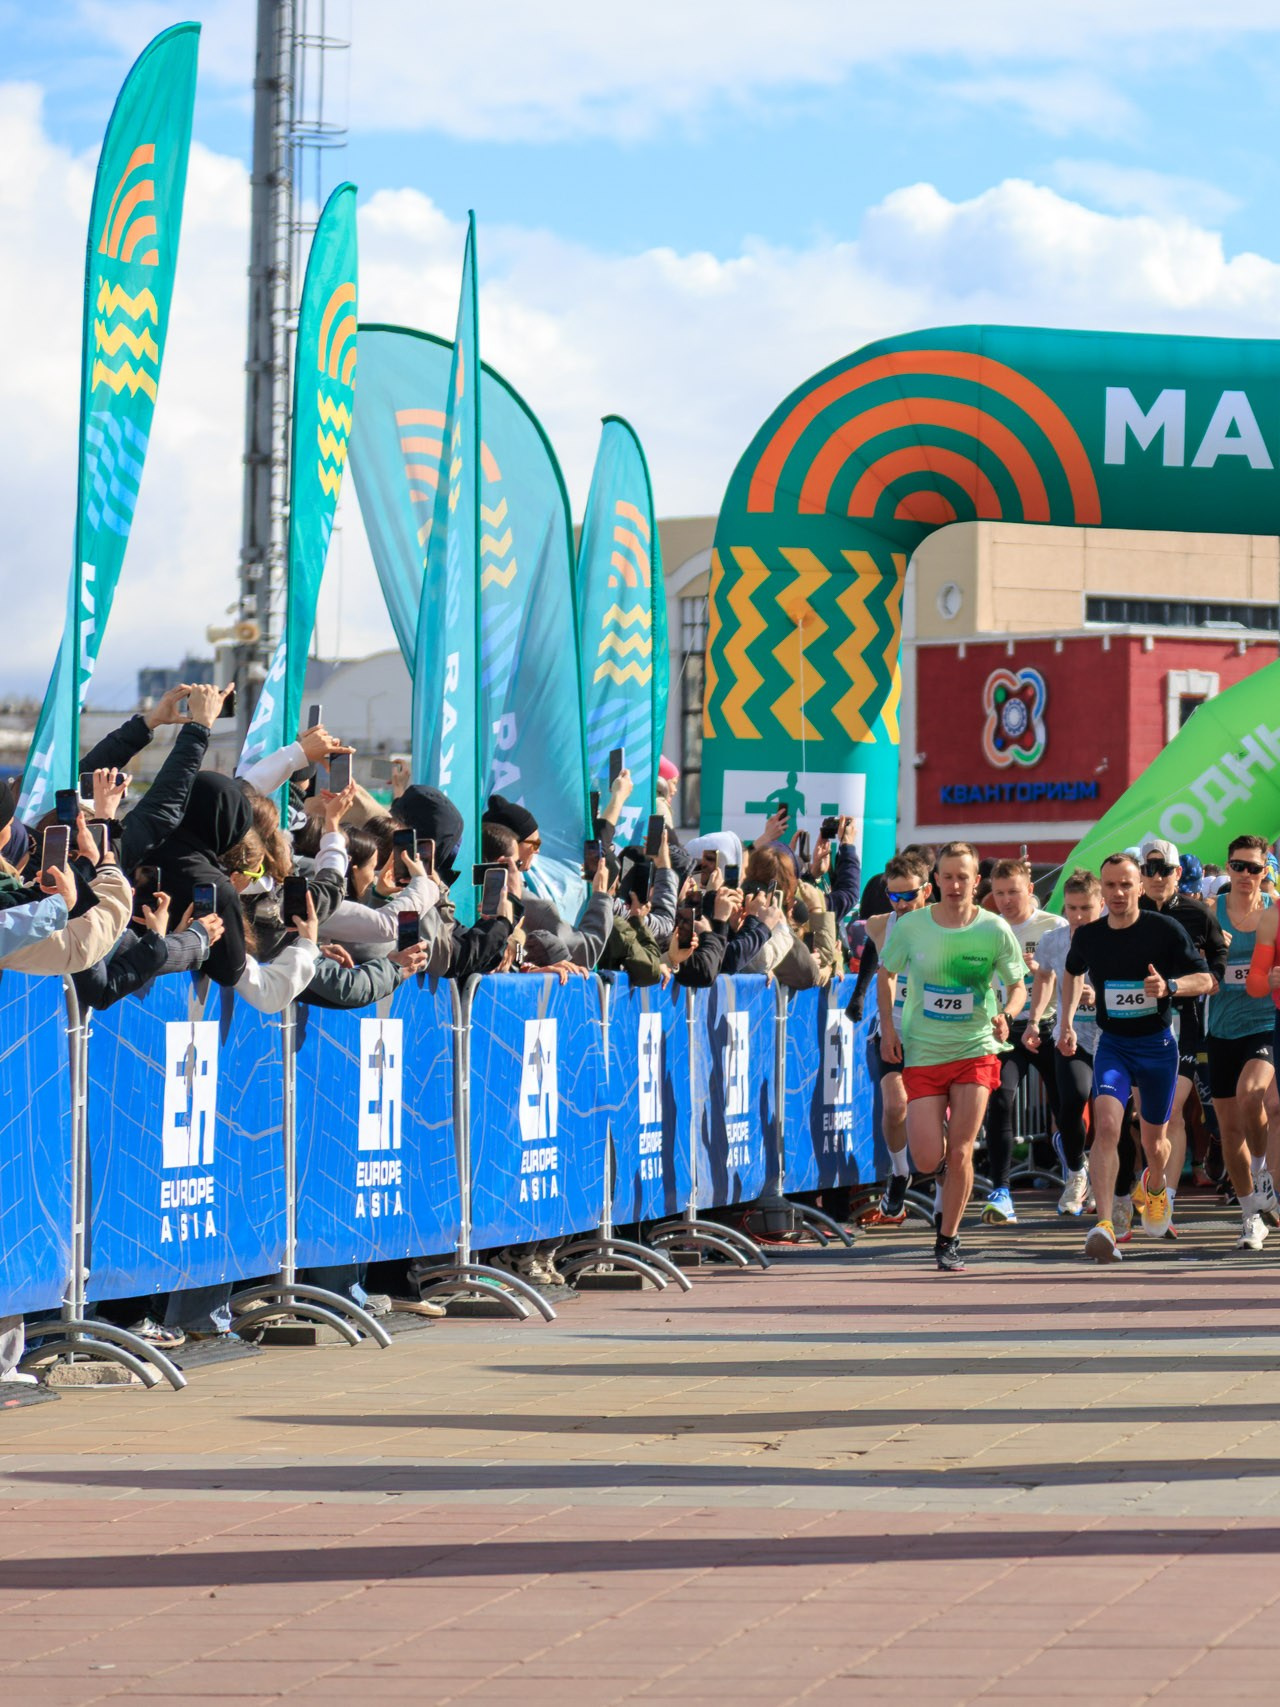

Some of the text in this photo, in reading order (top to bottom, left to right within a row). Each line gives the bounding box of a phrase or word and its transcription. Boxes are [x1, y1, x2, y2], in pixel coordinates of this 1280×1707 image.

[940, 781, 1098, 804] КВАНТОРИУМ
[934, 998, 962, 1010] 478
[1116, 993, 1145, 1005] 246
[726, 1121, 749, 1143] EUROPE
[823, 1111, 853, 1131] EUROPE
[639, 1131, 662, 1155] EUROPE
[823, 1133, 853, 1154] ASIA
[521, 1147, 558, 1174] EUROPE
[726, 1145, 750, 1168] ASIA
[356, 1160, 402, 1187] EUROPE
[641, 1157, 663, 1180] ASIA
[160, 1175, 214, 1209] EUROPE
[520, 1175, 558, 1202] ASIA
[355, 1191, 403, 1218] ASIA
[160, 1211, 216, 1243] ASIA
